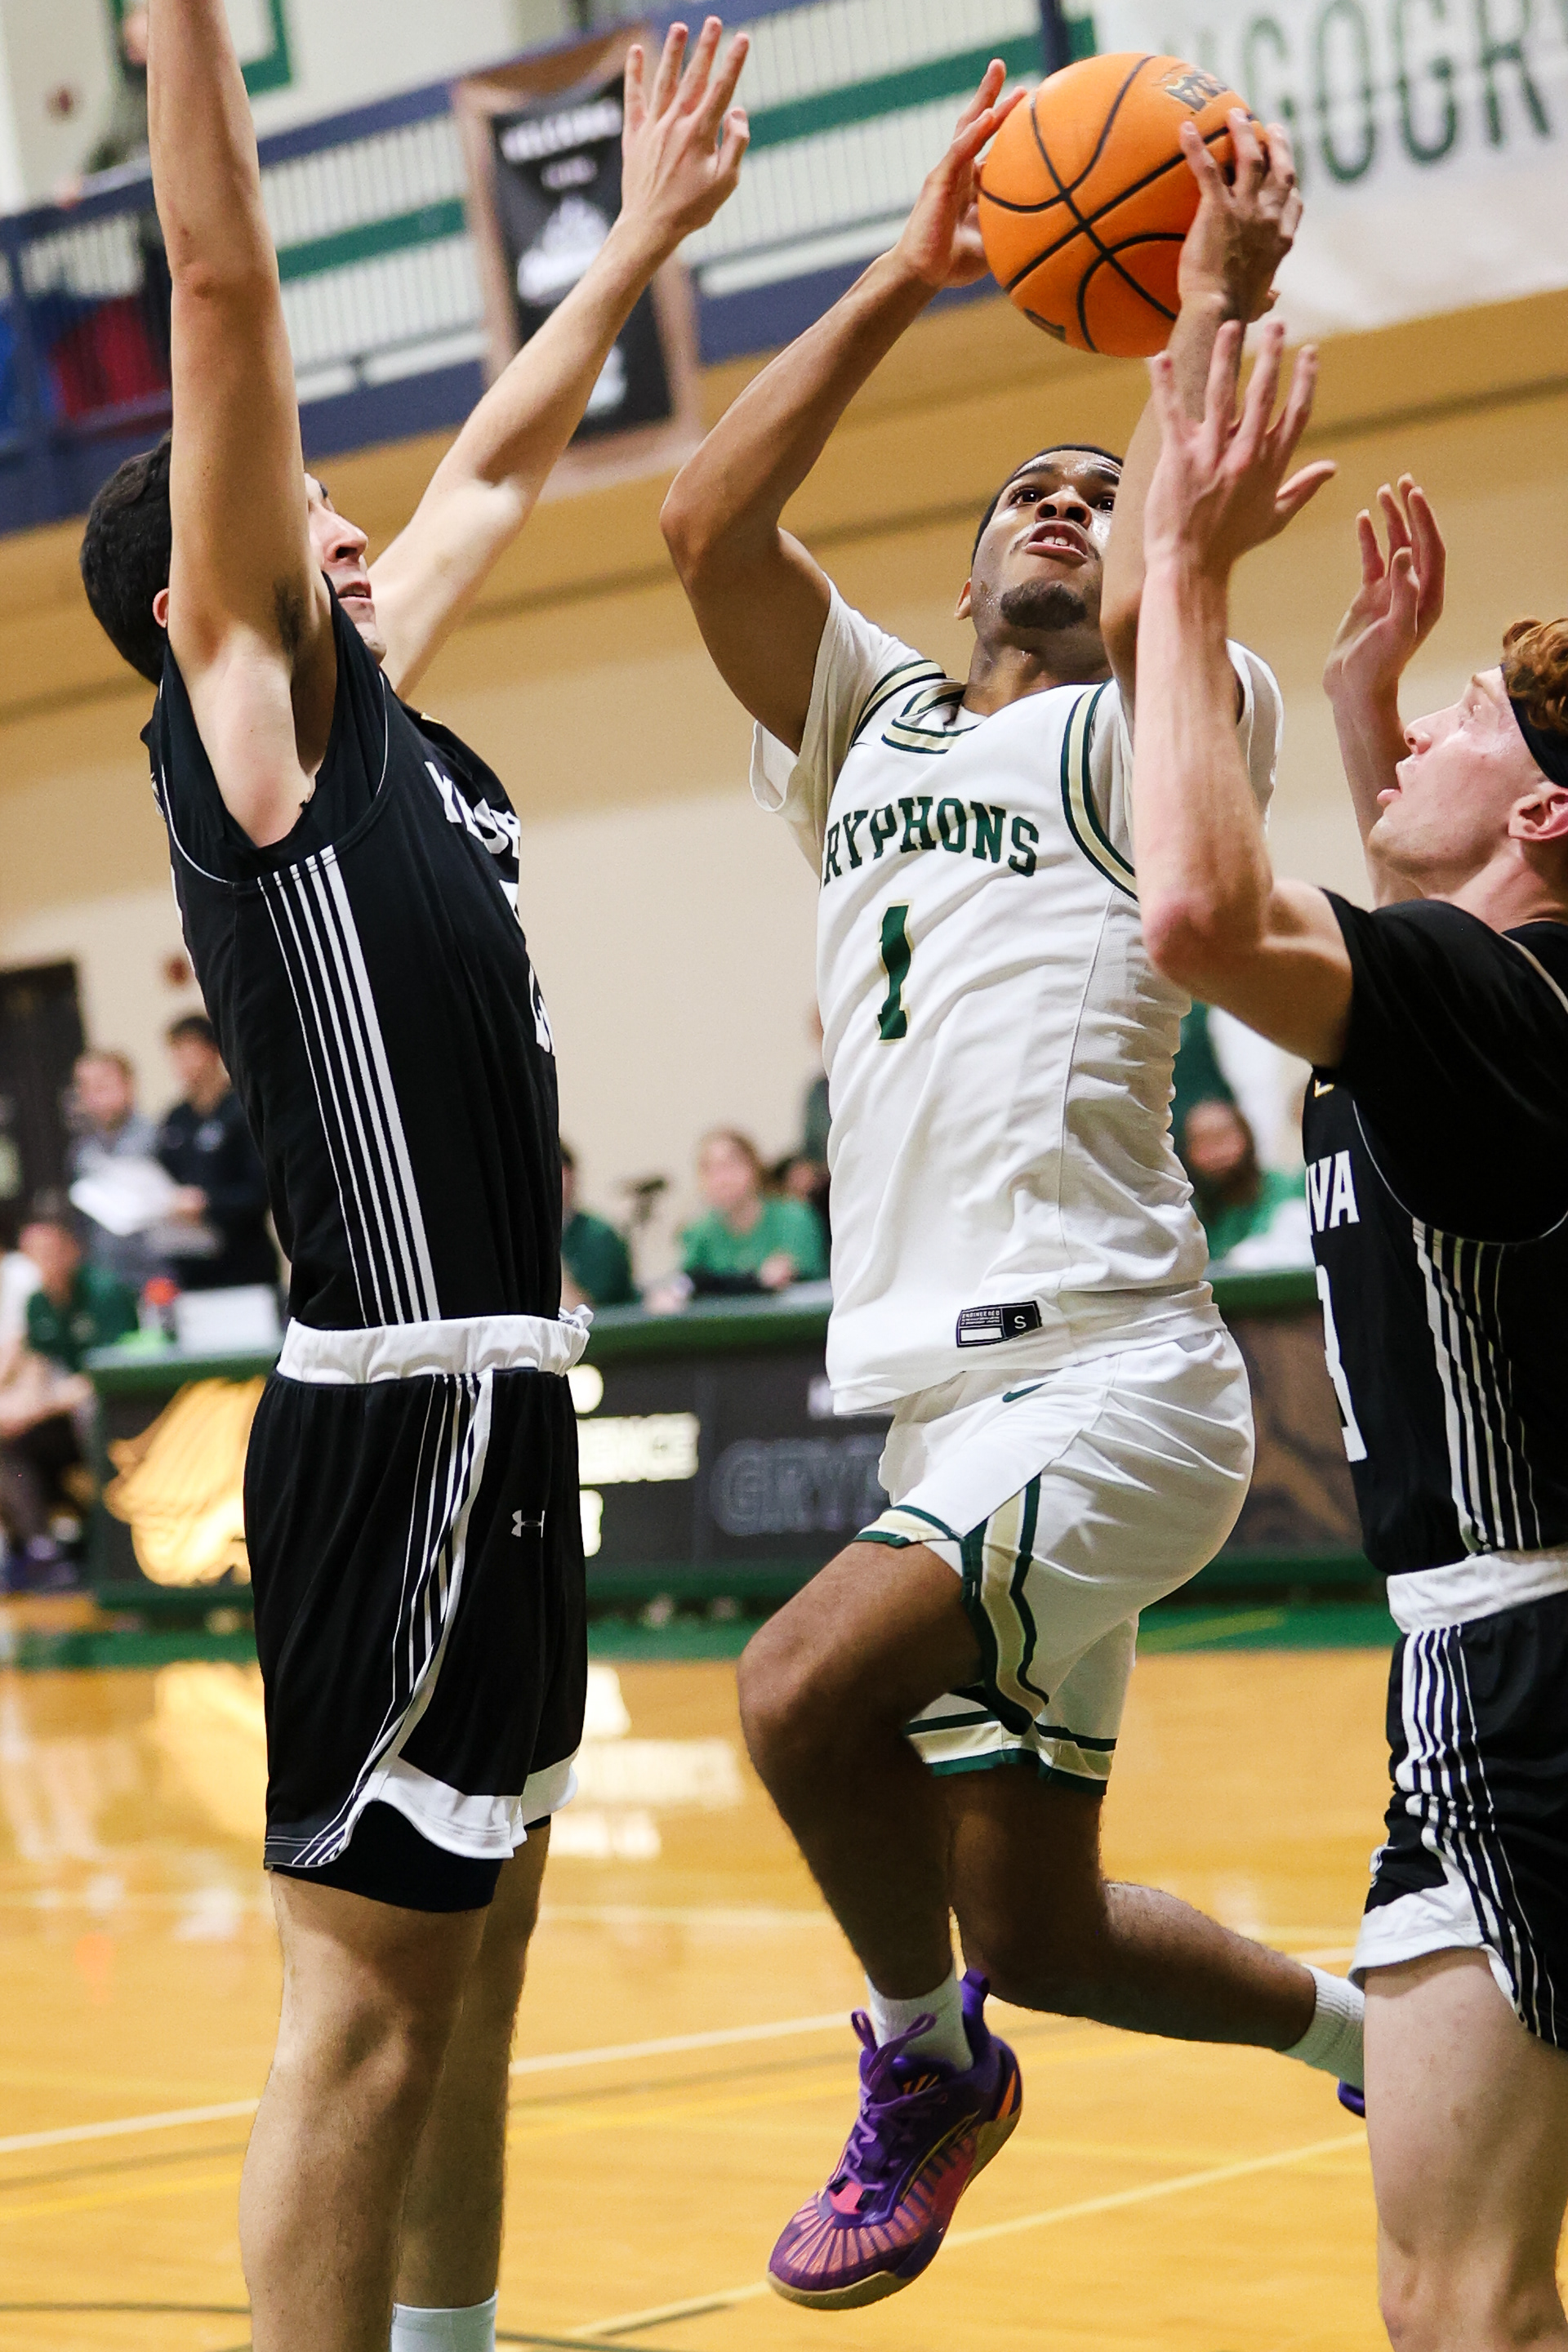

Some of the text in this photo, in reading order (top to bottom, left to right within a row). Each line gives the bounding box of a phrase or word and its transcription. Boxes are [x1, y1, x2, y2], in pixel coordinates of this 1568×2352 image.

[823, 796, 1039, 887] RYPHONS
[875, 899, 914, 1046] 1
[1013, 1315, 1027, 1330] S
